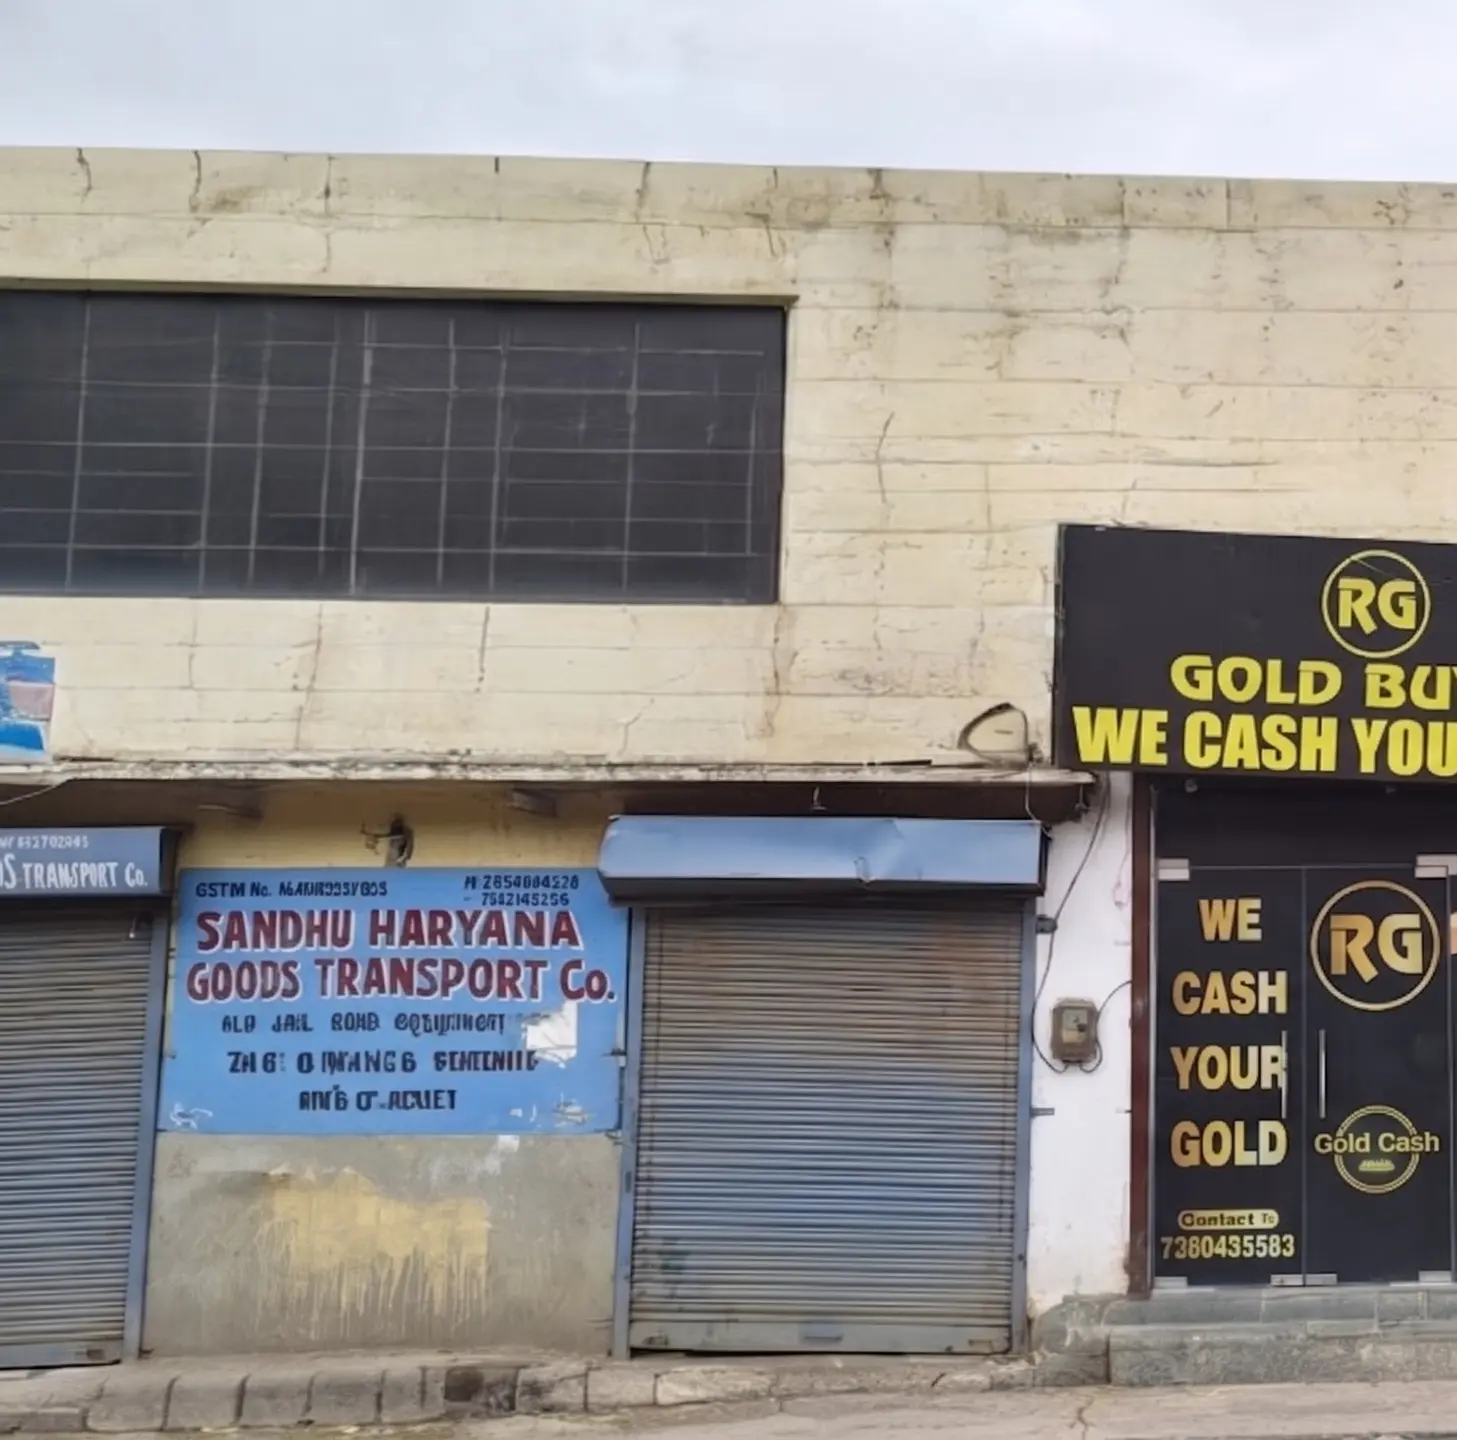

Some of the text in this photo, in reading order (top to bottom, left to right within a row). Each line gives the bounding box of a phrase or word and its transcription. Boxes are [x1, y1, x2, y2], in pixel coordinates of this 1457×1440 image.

[1338, 576, 1417, 635] RG
[1170, 654, 1343, 706] GOLD
[1072, 706, 1168, 766] WE
[1184, 712, 1338, 773] CASH
[0, 853, 17, 891] S
[22, 861, 119, 890] TRANSPORT
[197, 908, 584, 955] SANDHU HARYANA
[1198, 897, 1262, 942] WE
[1329, 913, 1423, 983] RG
[186, 957, 617, 1004] GOODS TRANSPORT Co.
[1172, 970, 1288, 1016] CASH
[1170, 1044, 1287, 1091] YOUR
[1170, 1120, 1288, 1167] GOLD
[1314, 1131, 1440, 1154] Gold Cash
[1181, 1212, 1255, 1228] Contact
